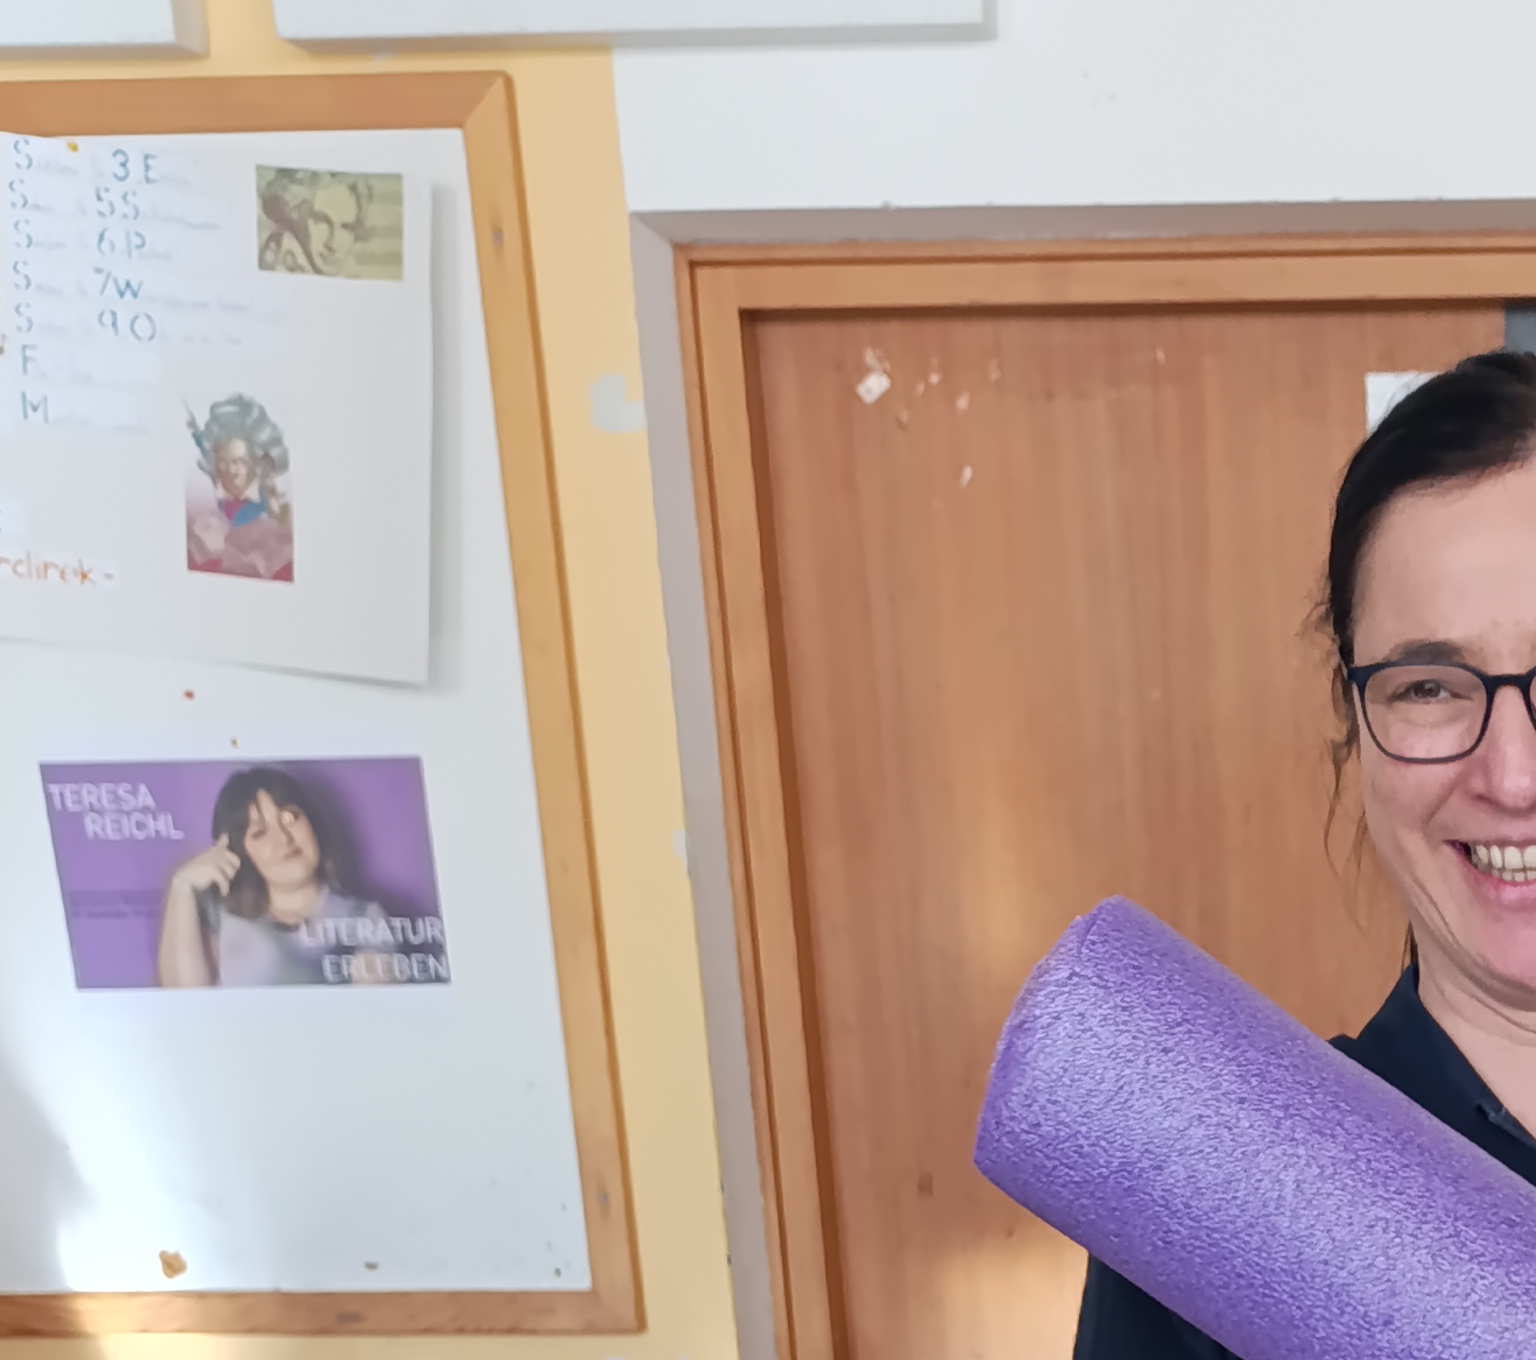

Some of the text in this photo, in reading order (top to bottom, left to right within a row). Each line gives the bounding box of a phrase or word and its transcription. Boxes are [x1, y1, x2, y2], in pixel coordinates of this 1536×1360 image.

[48, 782, 157, 812] TERESA
[84, 812, 185, 841] REICHL
[301, 916, 444, 946] LITERATUR
[323, 952, 448, 982] ERLEBEN
